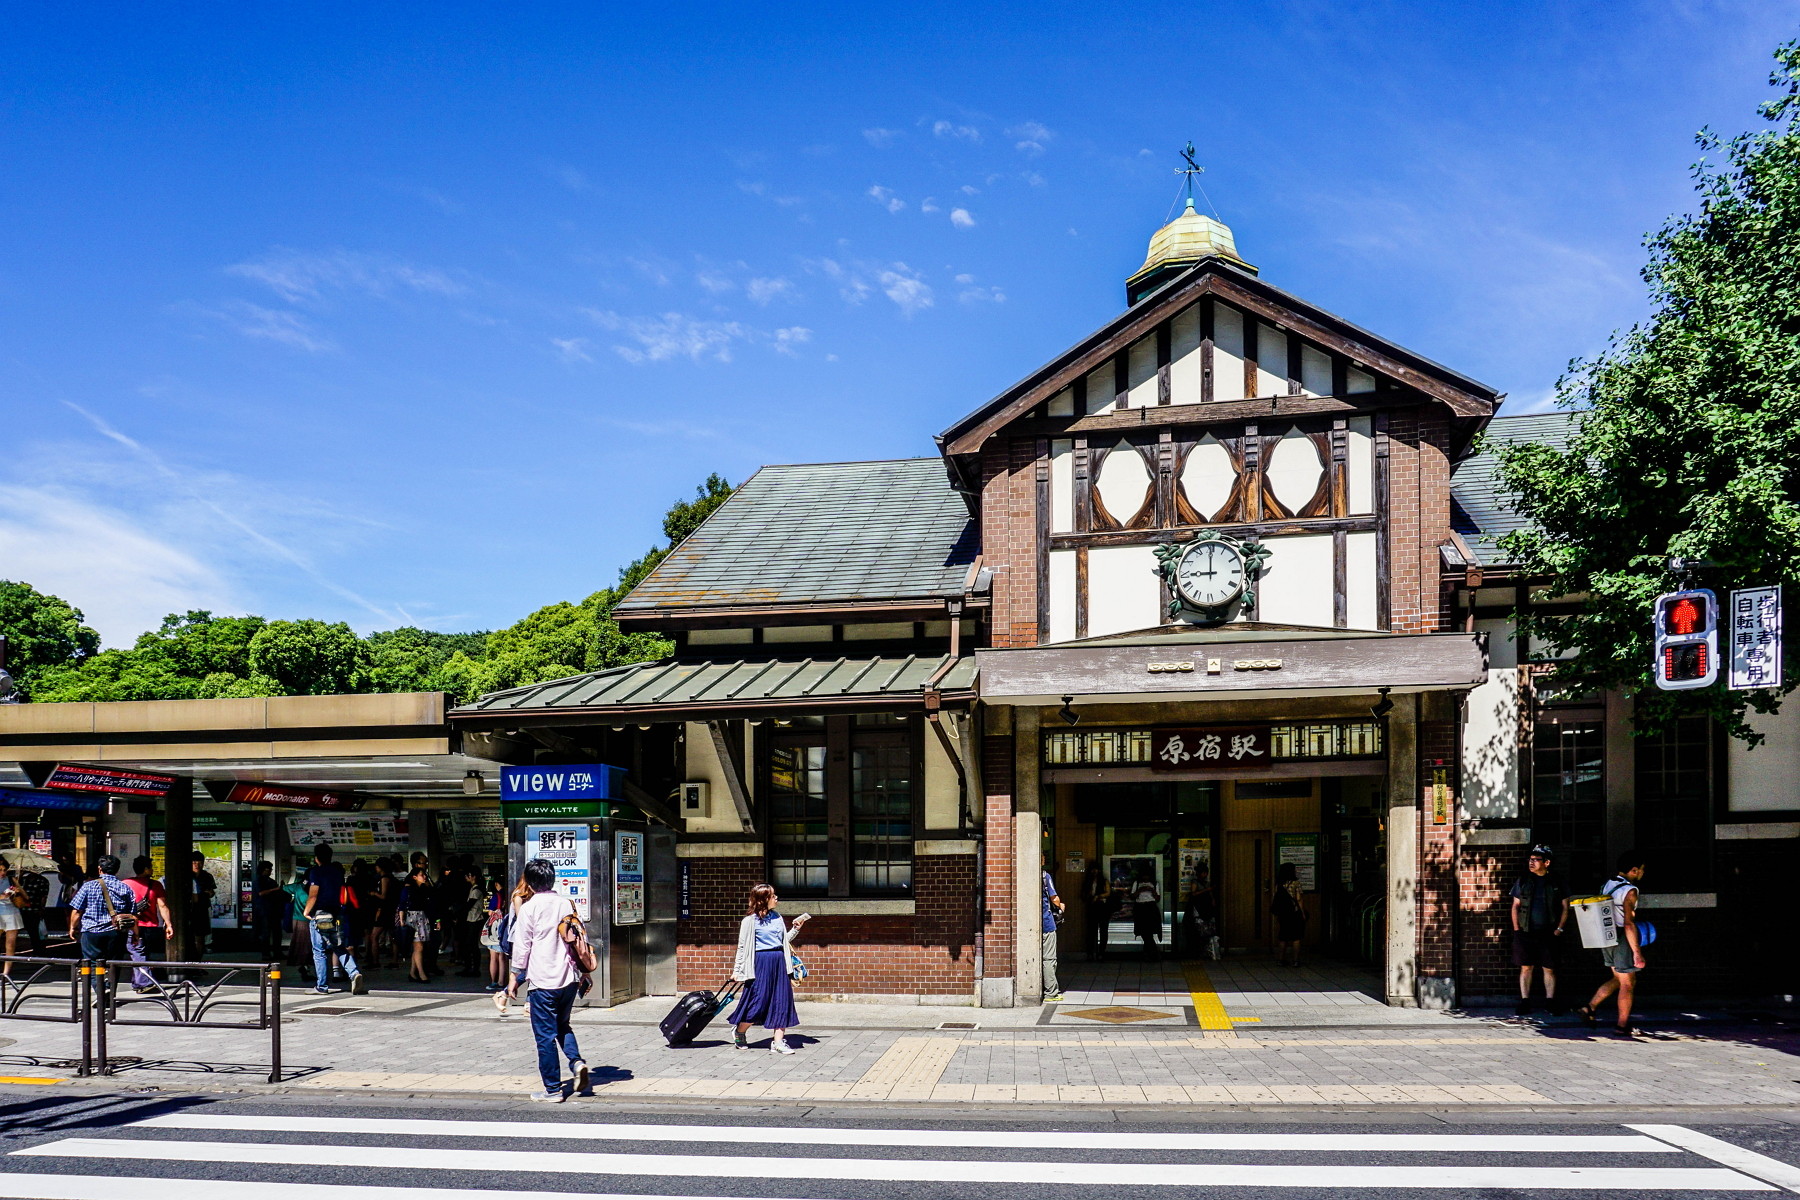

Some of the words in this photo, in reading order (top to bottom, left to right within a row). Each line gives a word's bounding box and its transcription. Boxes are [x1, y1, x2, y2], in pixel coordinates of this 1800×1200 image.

[1736, 597, 1755, 647] 自転車
[1756, 595, 1775, 645] 歩行者
[1746, 647, 1764, 681] 専用
[1160, 734, 1266, 766] 原宿駅
[569, 773, 592, 783] ATM
[568, 783, 594, 791] コーナー
[262, 792, 310, 804] McDonald's
[540, 832, 575, 849] 銀行
[622, 838, 637, 855] 銀行
[552, 859, 577, 867] 出しOK
